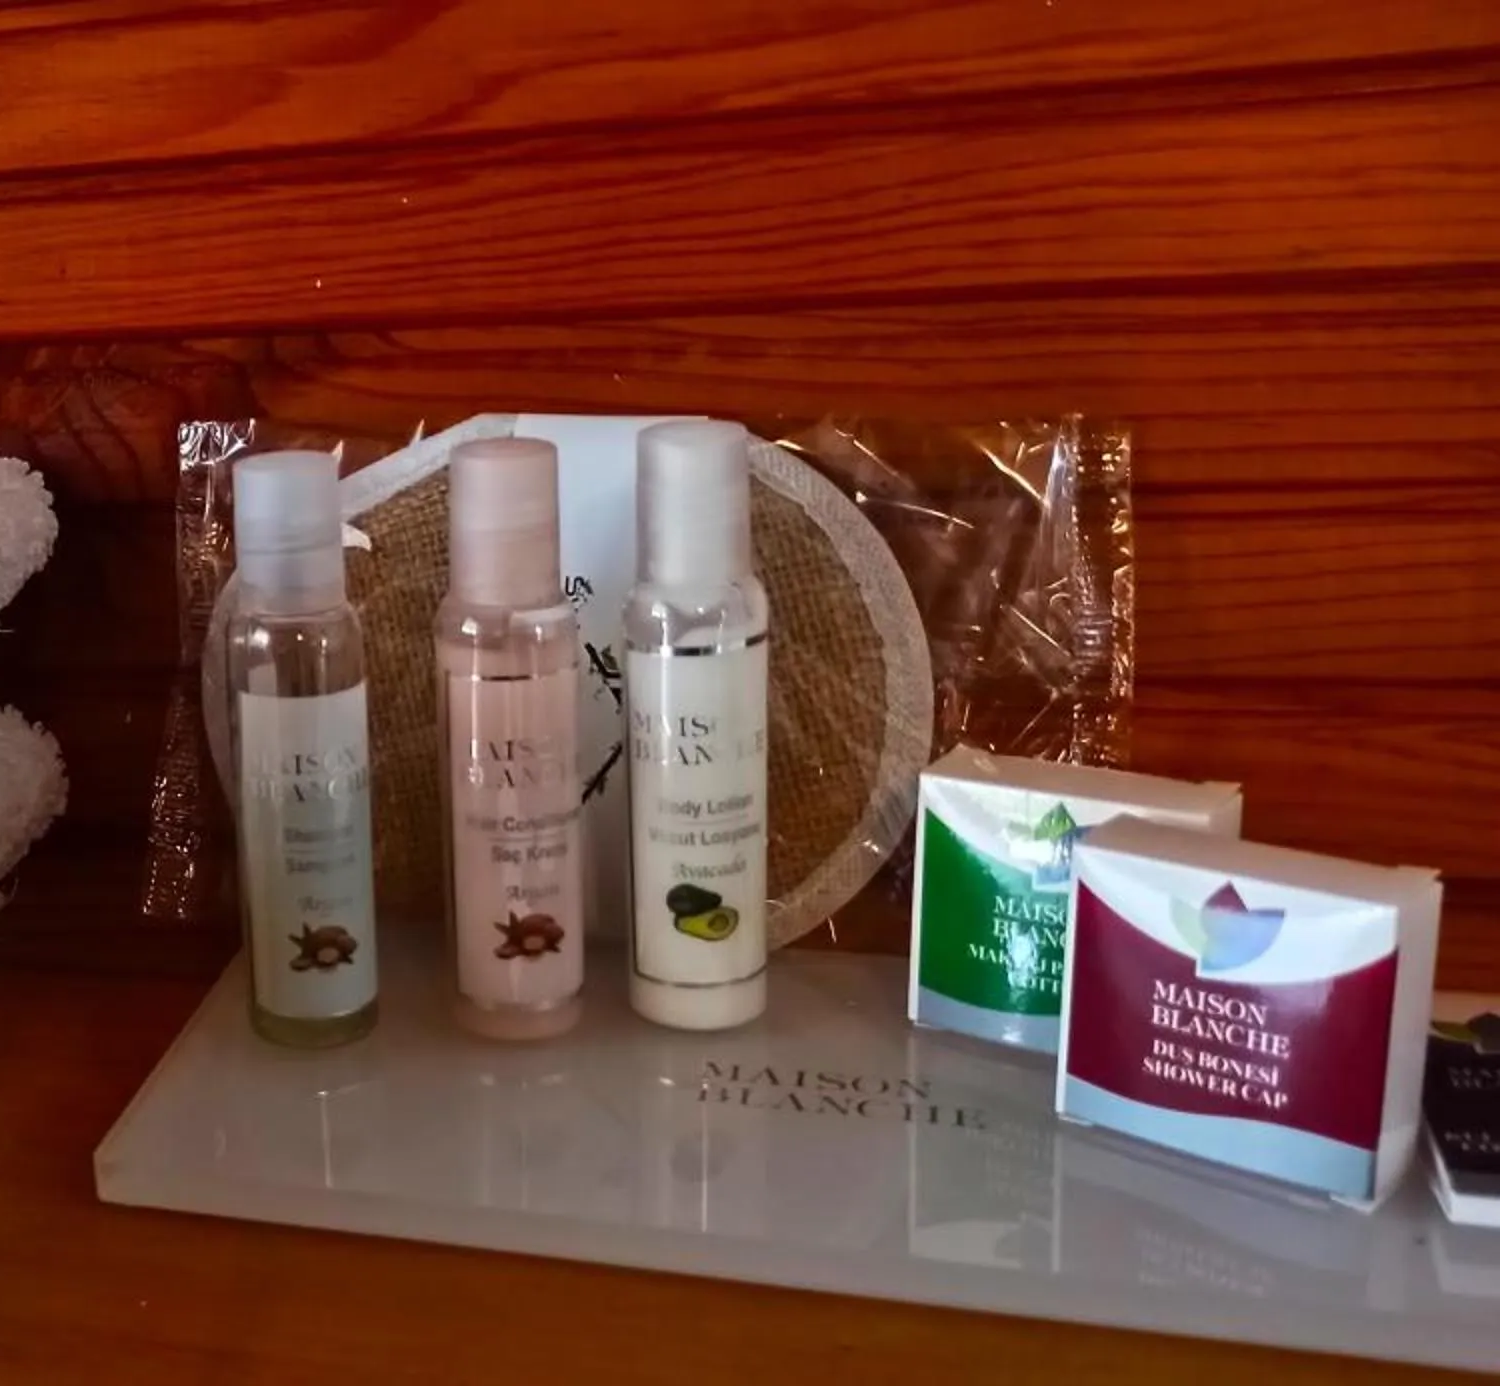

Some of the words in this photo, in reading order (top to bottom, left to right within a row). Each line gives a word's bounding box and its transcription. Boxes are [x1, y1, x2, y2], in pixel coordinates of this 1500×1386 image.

[1153, 979, 1267, 1027] MAISON
[1151, 1004, 1290, 1059] BLANCHE
[706, 1061, 932, 1099] MAISON
[1142, 1056, 1237, 1097] SHOWER
[1241, 1083, 1288, 1110] CAP
